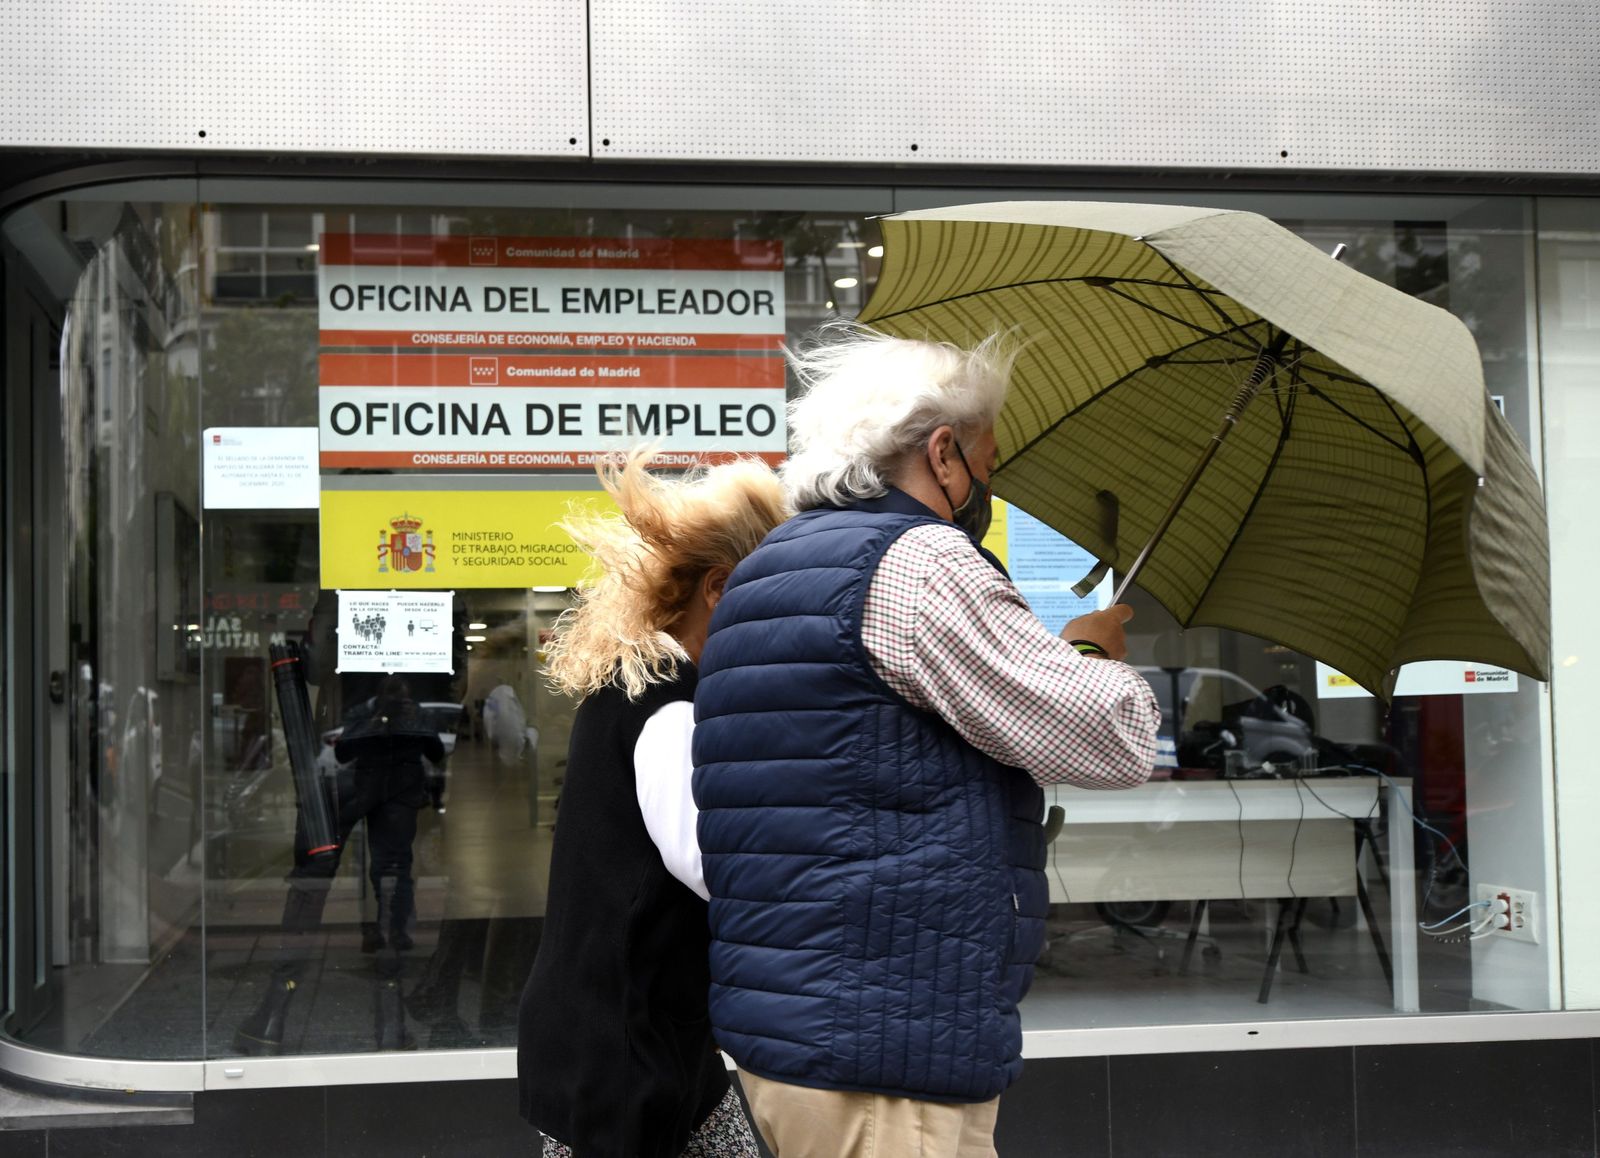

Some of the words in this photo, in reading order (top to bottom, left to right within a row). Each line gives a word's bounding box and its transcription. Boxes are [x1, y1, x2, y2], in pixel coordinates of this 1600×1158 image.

[506, 247, 575, 258] Comunidad
[579, 247, 593, 258] de
[597, 248, 640, 259] Madrid
[329, 284, 472, 312] OFICINA
[484, 287, 550, 313] DEL
[561, 288, 775, 316] EMPLEADOR
[412, 332, 485, 345] CONSEJERÍA
[489, 335, 505, 345] DE
[508, 333, 573, 346] ECONOMÍA,
[577, 335, 624, 346] EMPLEO
[627, 335, 636, 346] Y
[637, 335, 697, 347] HACIENDA
[507, 366, 576, 377] Comunidad
[579, 367, 595, 377] de
[598, 367, 641, 378] Madrid
[330, 402, 511, 436] OFICINA
[526, 403, 582, 436] DE
[598, 403, 776, 437] EMPLEO
[413, 453, 487, 465] CONSEJERÍA
[490, 455, 506, 465] DE
[509, 454, 575, 466] ECONOMÍA,
[639, 455, 698, 466] ACIENDA
[452, 532, 514, 541] MINISTERIO
[452, 544, 468, 554] DE
[470, 544, 518, 556] TRABAJO,
[520, 544, 594, 554] MIGRACION
[452, 557, 460, 566] Y
[462, 557, 525, 566] SEGURIDAD
[528, 557, 567, 566] SOCIAL
